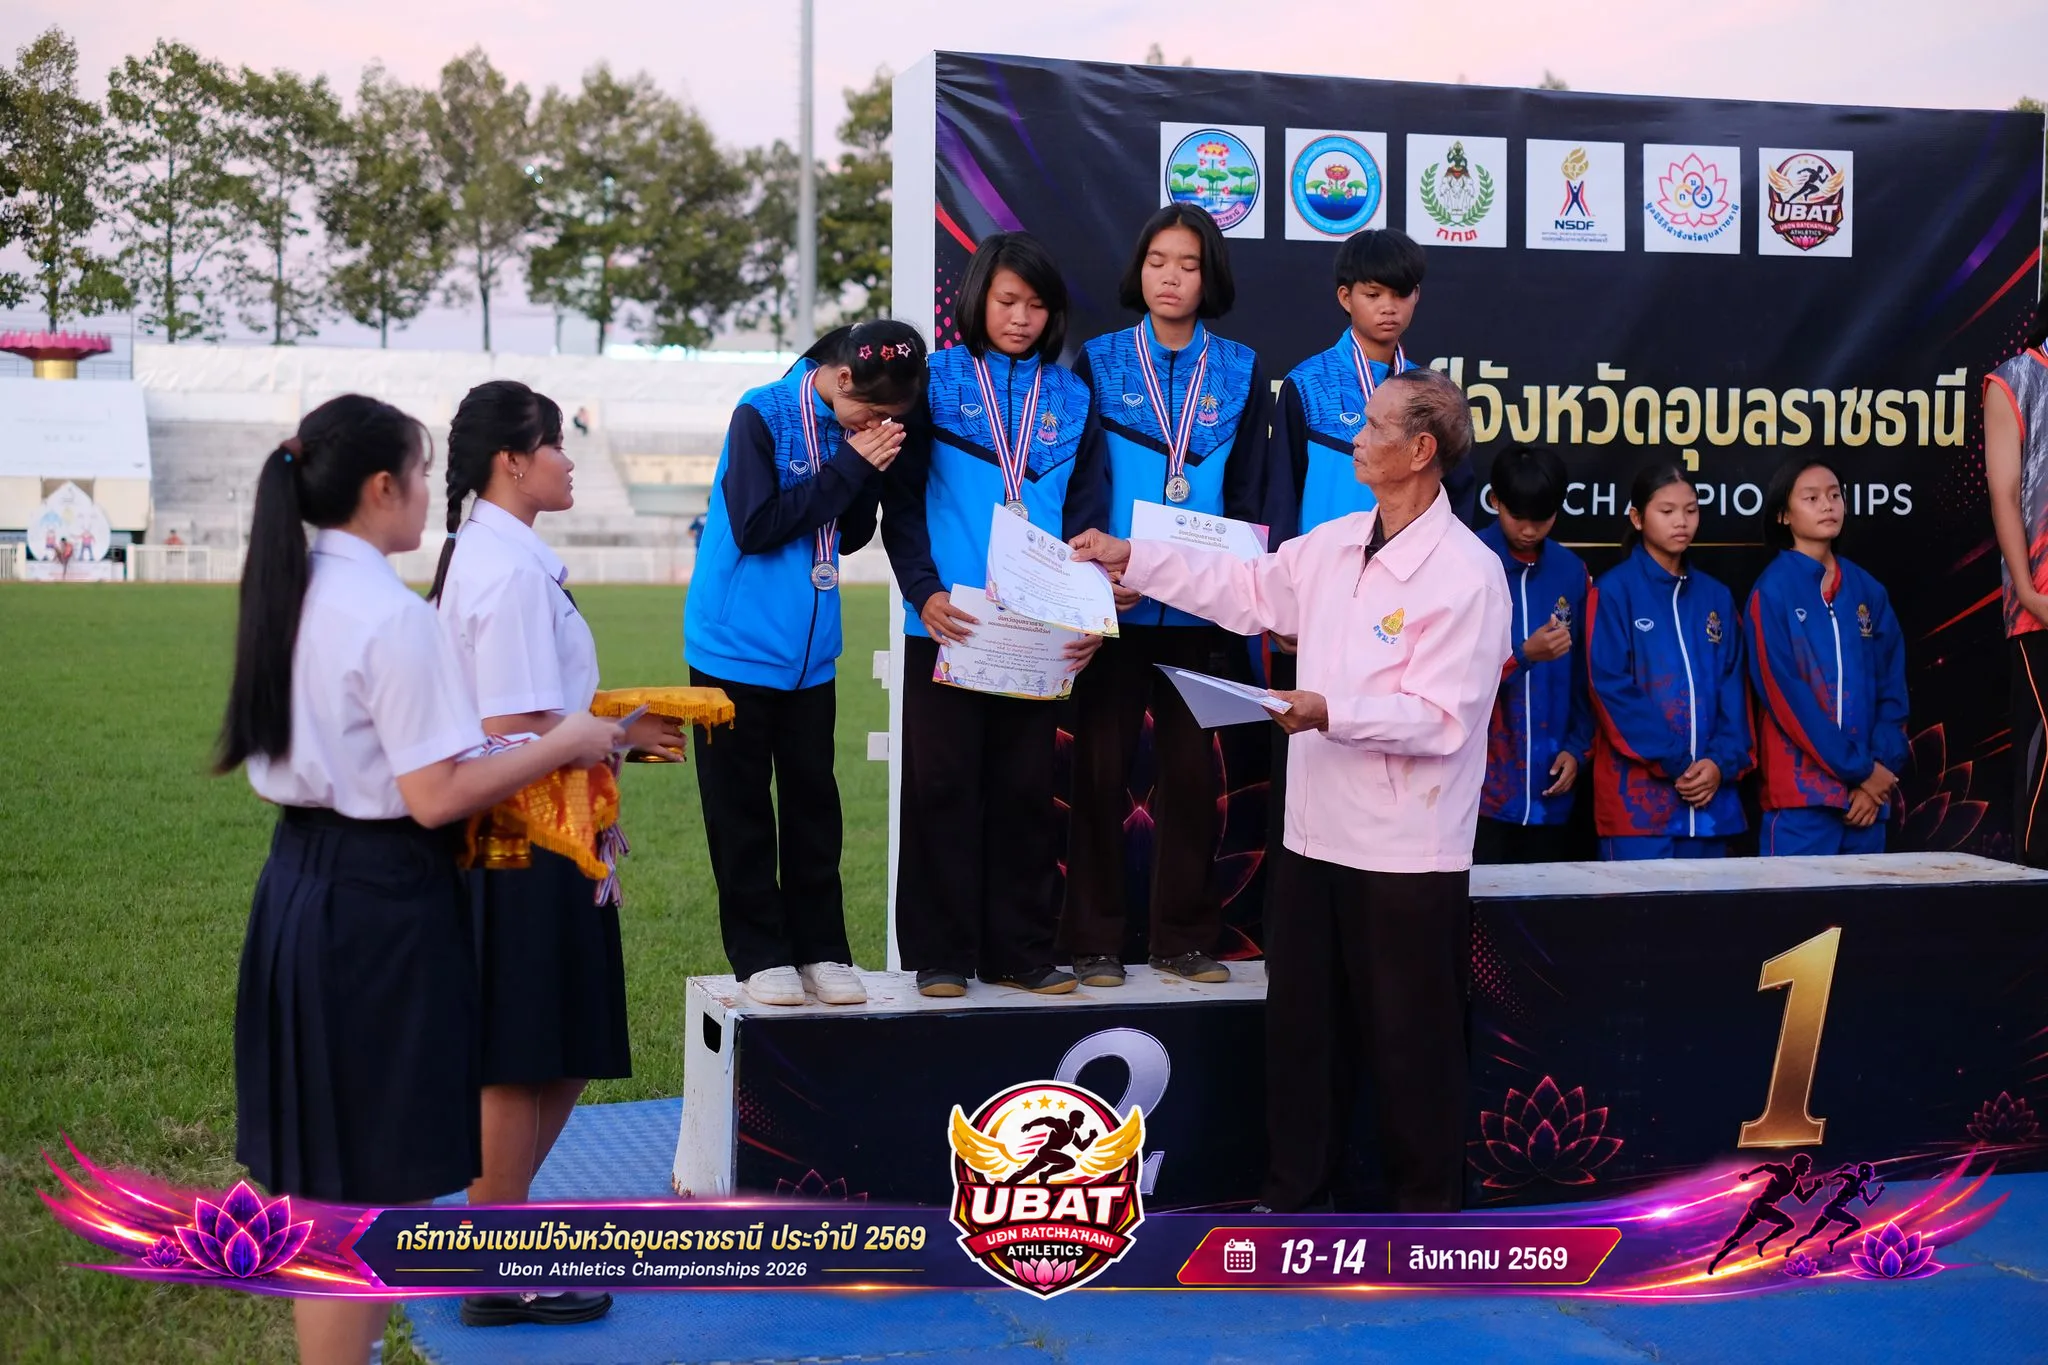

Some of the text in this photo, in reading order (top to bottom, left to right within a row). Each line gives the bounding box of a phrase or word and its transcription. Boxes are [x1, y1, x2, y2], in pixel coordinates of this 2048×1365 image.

[1554, 219, 1595, 231] NSDF
[1774, 202, 1838, 223] UBAT
[1429, 357, 1967, 472] จังหวัดอุบลราชธานี
[1562, 482, 1913, 516] CHPIOIPS
[1737, 927, 1842, 1148] 1
